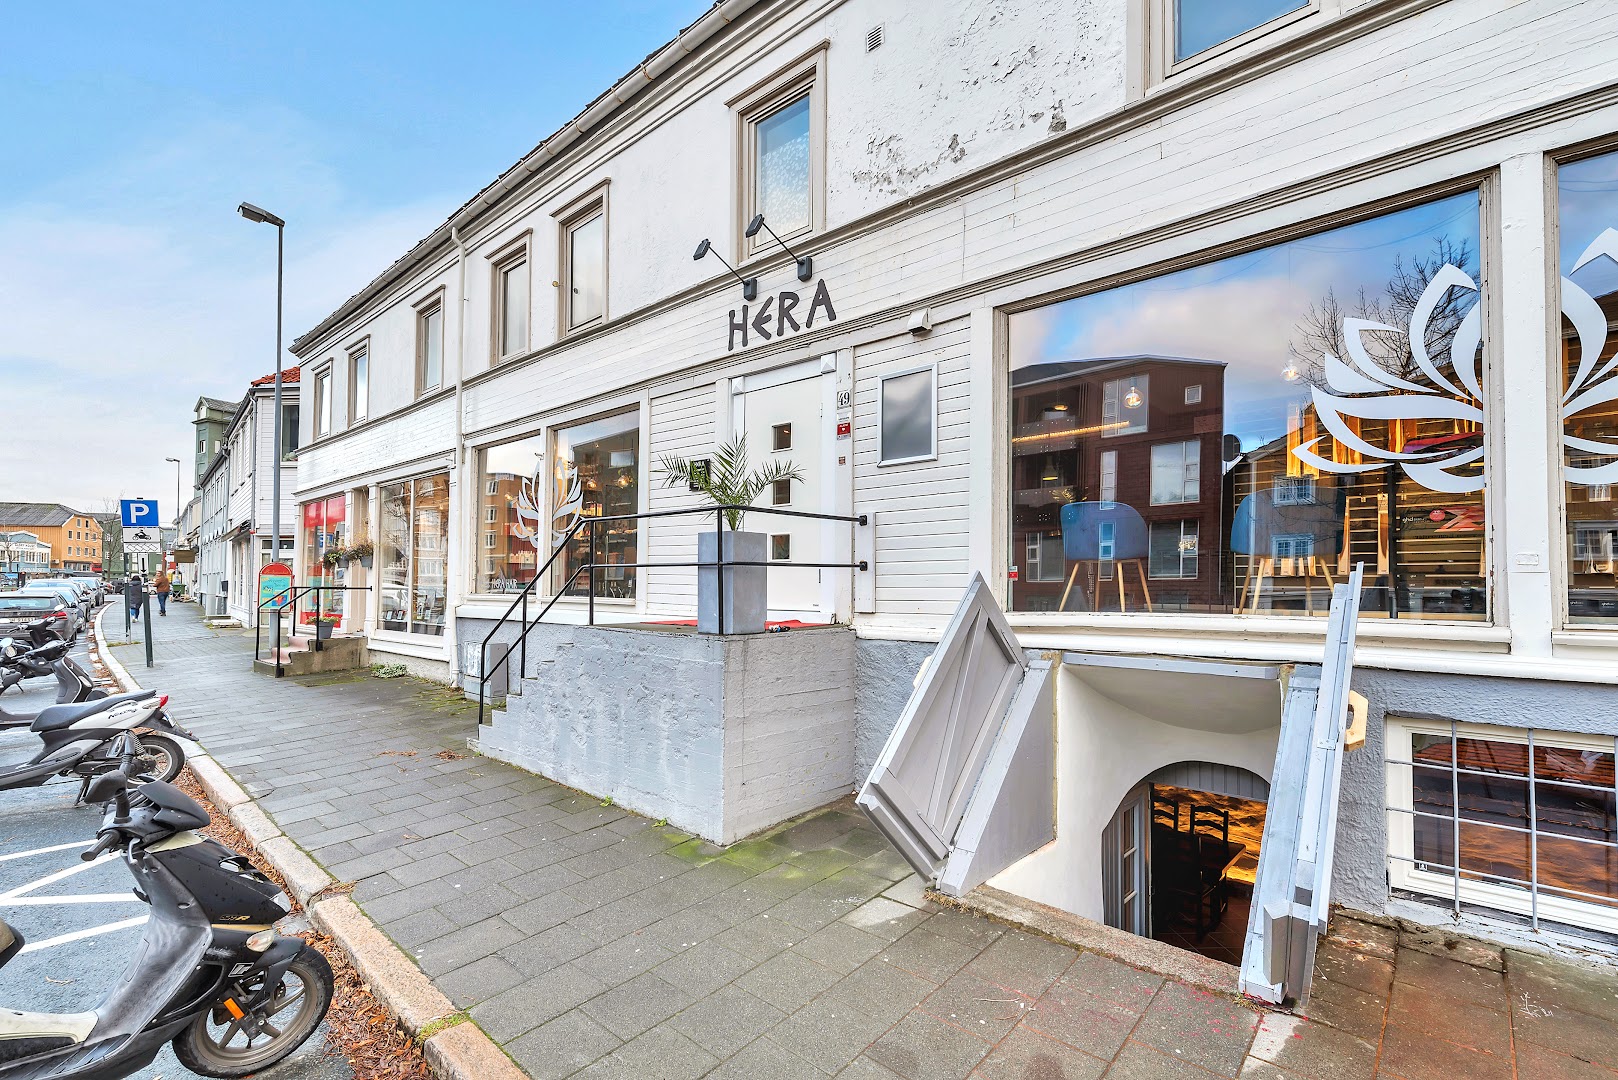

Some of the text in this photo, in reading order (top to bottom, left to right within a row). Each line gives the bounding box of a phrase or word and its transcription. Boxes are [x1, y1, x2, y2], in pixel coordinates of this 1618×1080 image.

[728, 279, 837, 351] HERA
[838, 392, 850, 405] 49
[130, 503, 150, 524] P
